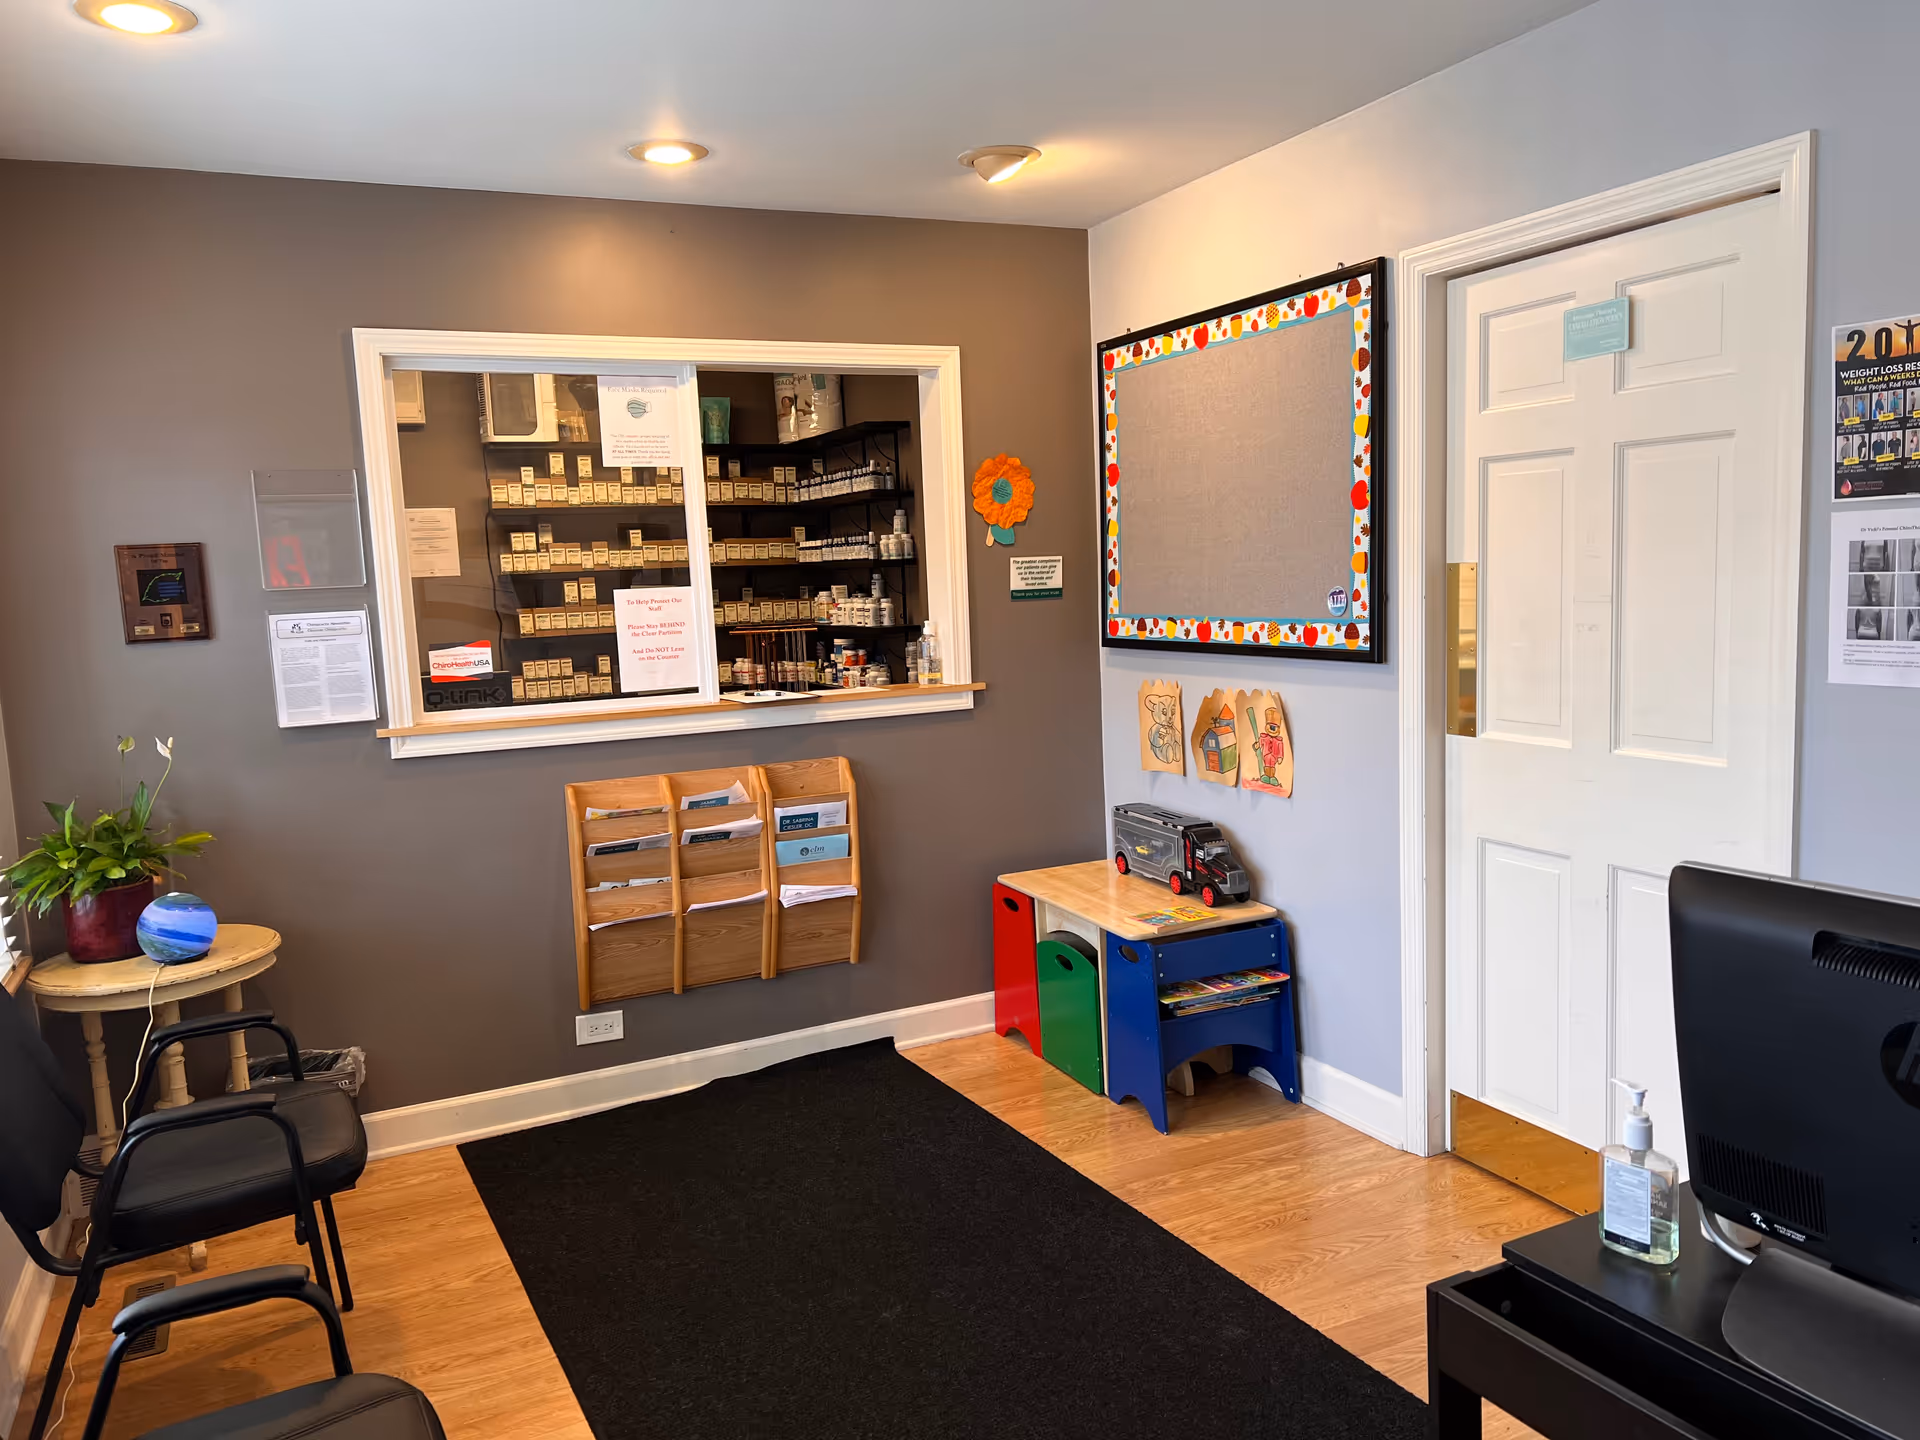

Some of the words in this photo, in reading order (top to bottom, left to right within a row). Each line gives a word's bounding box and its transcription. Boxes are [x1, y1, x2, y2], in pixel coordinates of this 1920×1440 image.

[1840, 366, 1880, 379] WEIGHT
[1881, 363, 1903, 375] LOSS
[1843, 377, 1866, 386] WHAT
[1867, 375, 1883, 383] CAN
[1890, 371, 1915, 380] WEEKS
[635, 598, 650, 606] Help
[646, 623, 658, 631] Stay
[659, 621, 686, 629] BEHIND
[431, 659, 491, 670] ChiroHealthUSA
[792, 816, 815, 824] SABRINA
